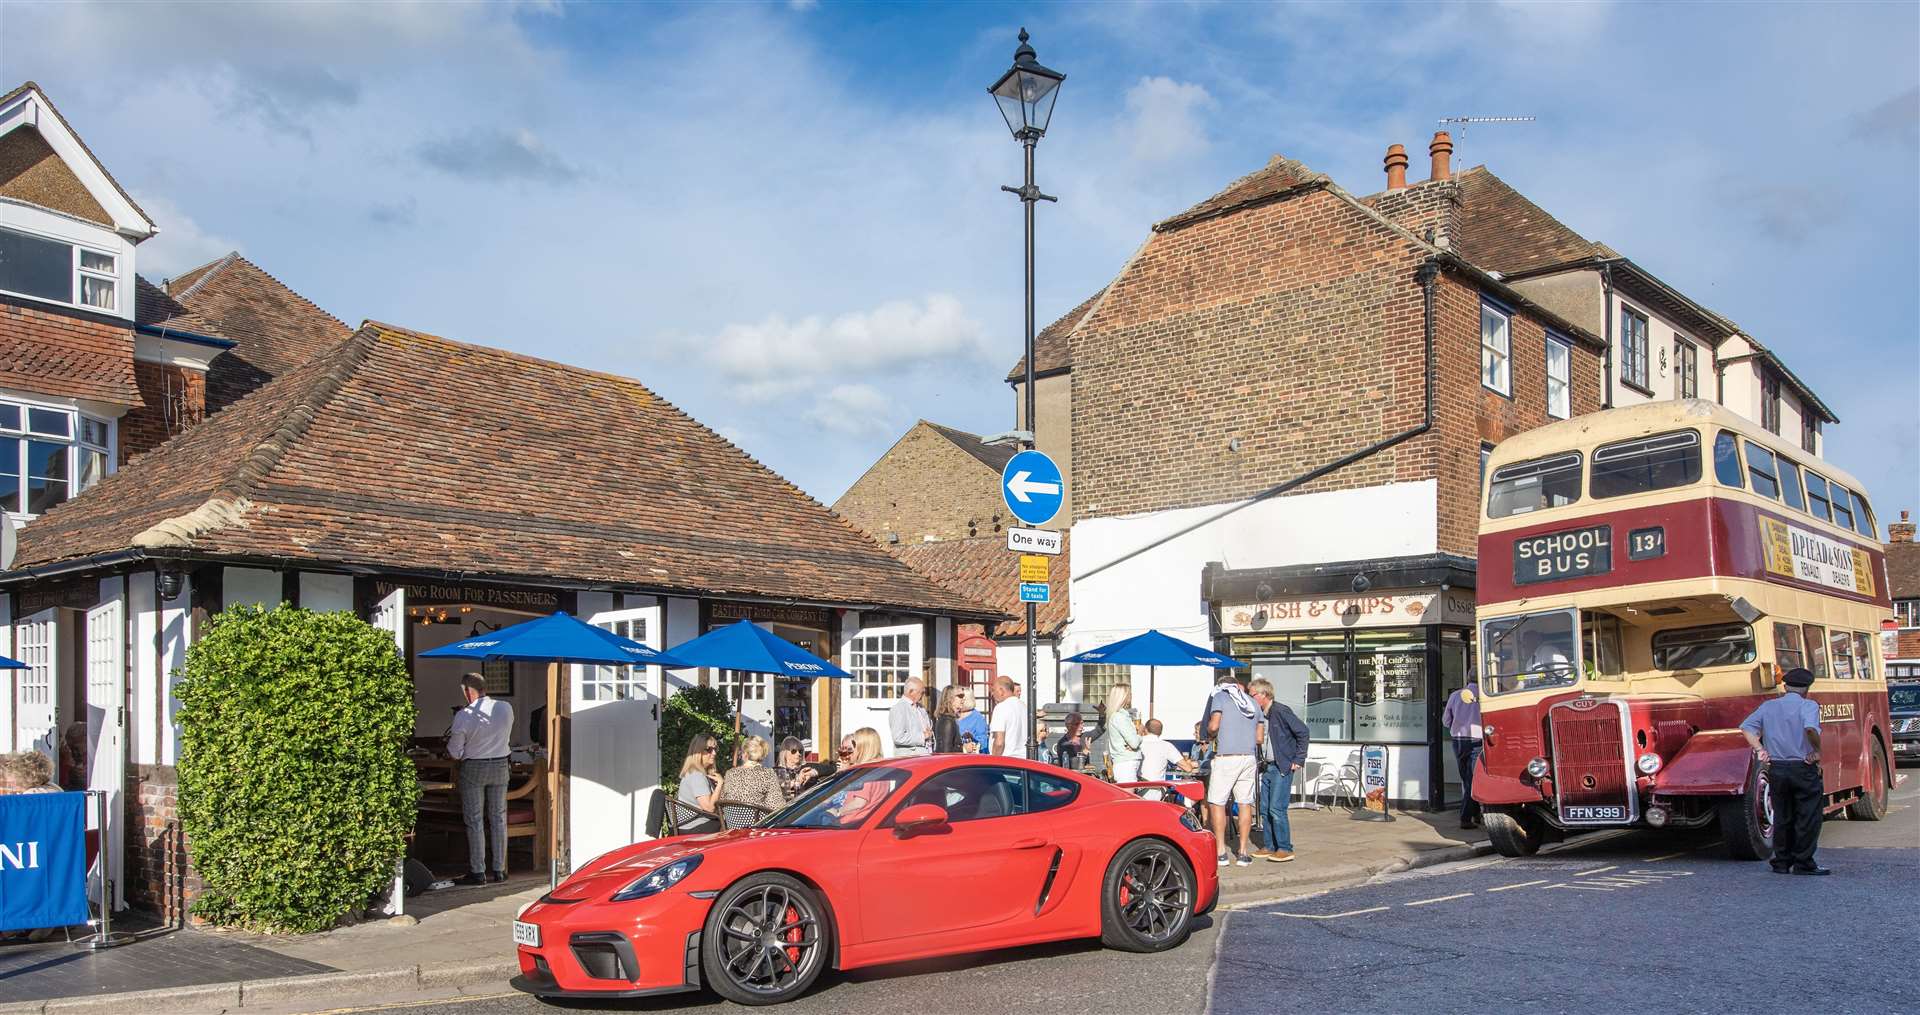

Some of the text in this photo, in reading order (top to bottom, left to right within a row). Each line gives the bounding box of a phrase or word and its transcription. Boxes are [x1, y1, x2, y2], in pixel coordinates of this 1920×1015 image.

[1012, 533, 1057, 549] One way
[1518, 529, 1609, 559] SCHOOL
[1537, 552, 1590, 576] BUS
[375, 581, 558, 606] WAING ROOM FOR PASSENGERS
[1258, 600, 1302, 620] FISH
[1307, 598, 1327, 617] &
[1332, 596, 1394, 617] CHIPS
[1575, 700, 1594, 708] GUY
[1819, 703, 1855, 720] EAST KENT
[1367, 758, 1382, 769] FISH
[1366, 775, 1385, 786] CHIPS
[1569, 807, 1620, 818] FFN 399
